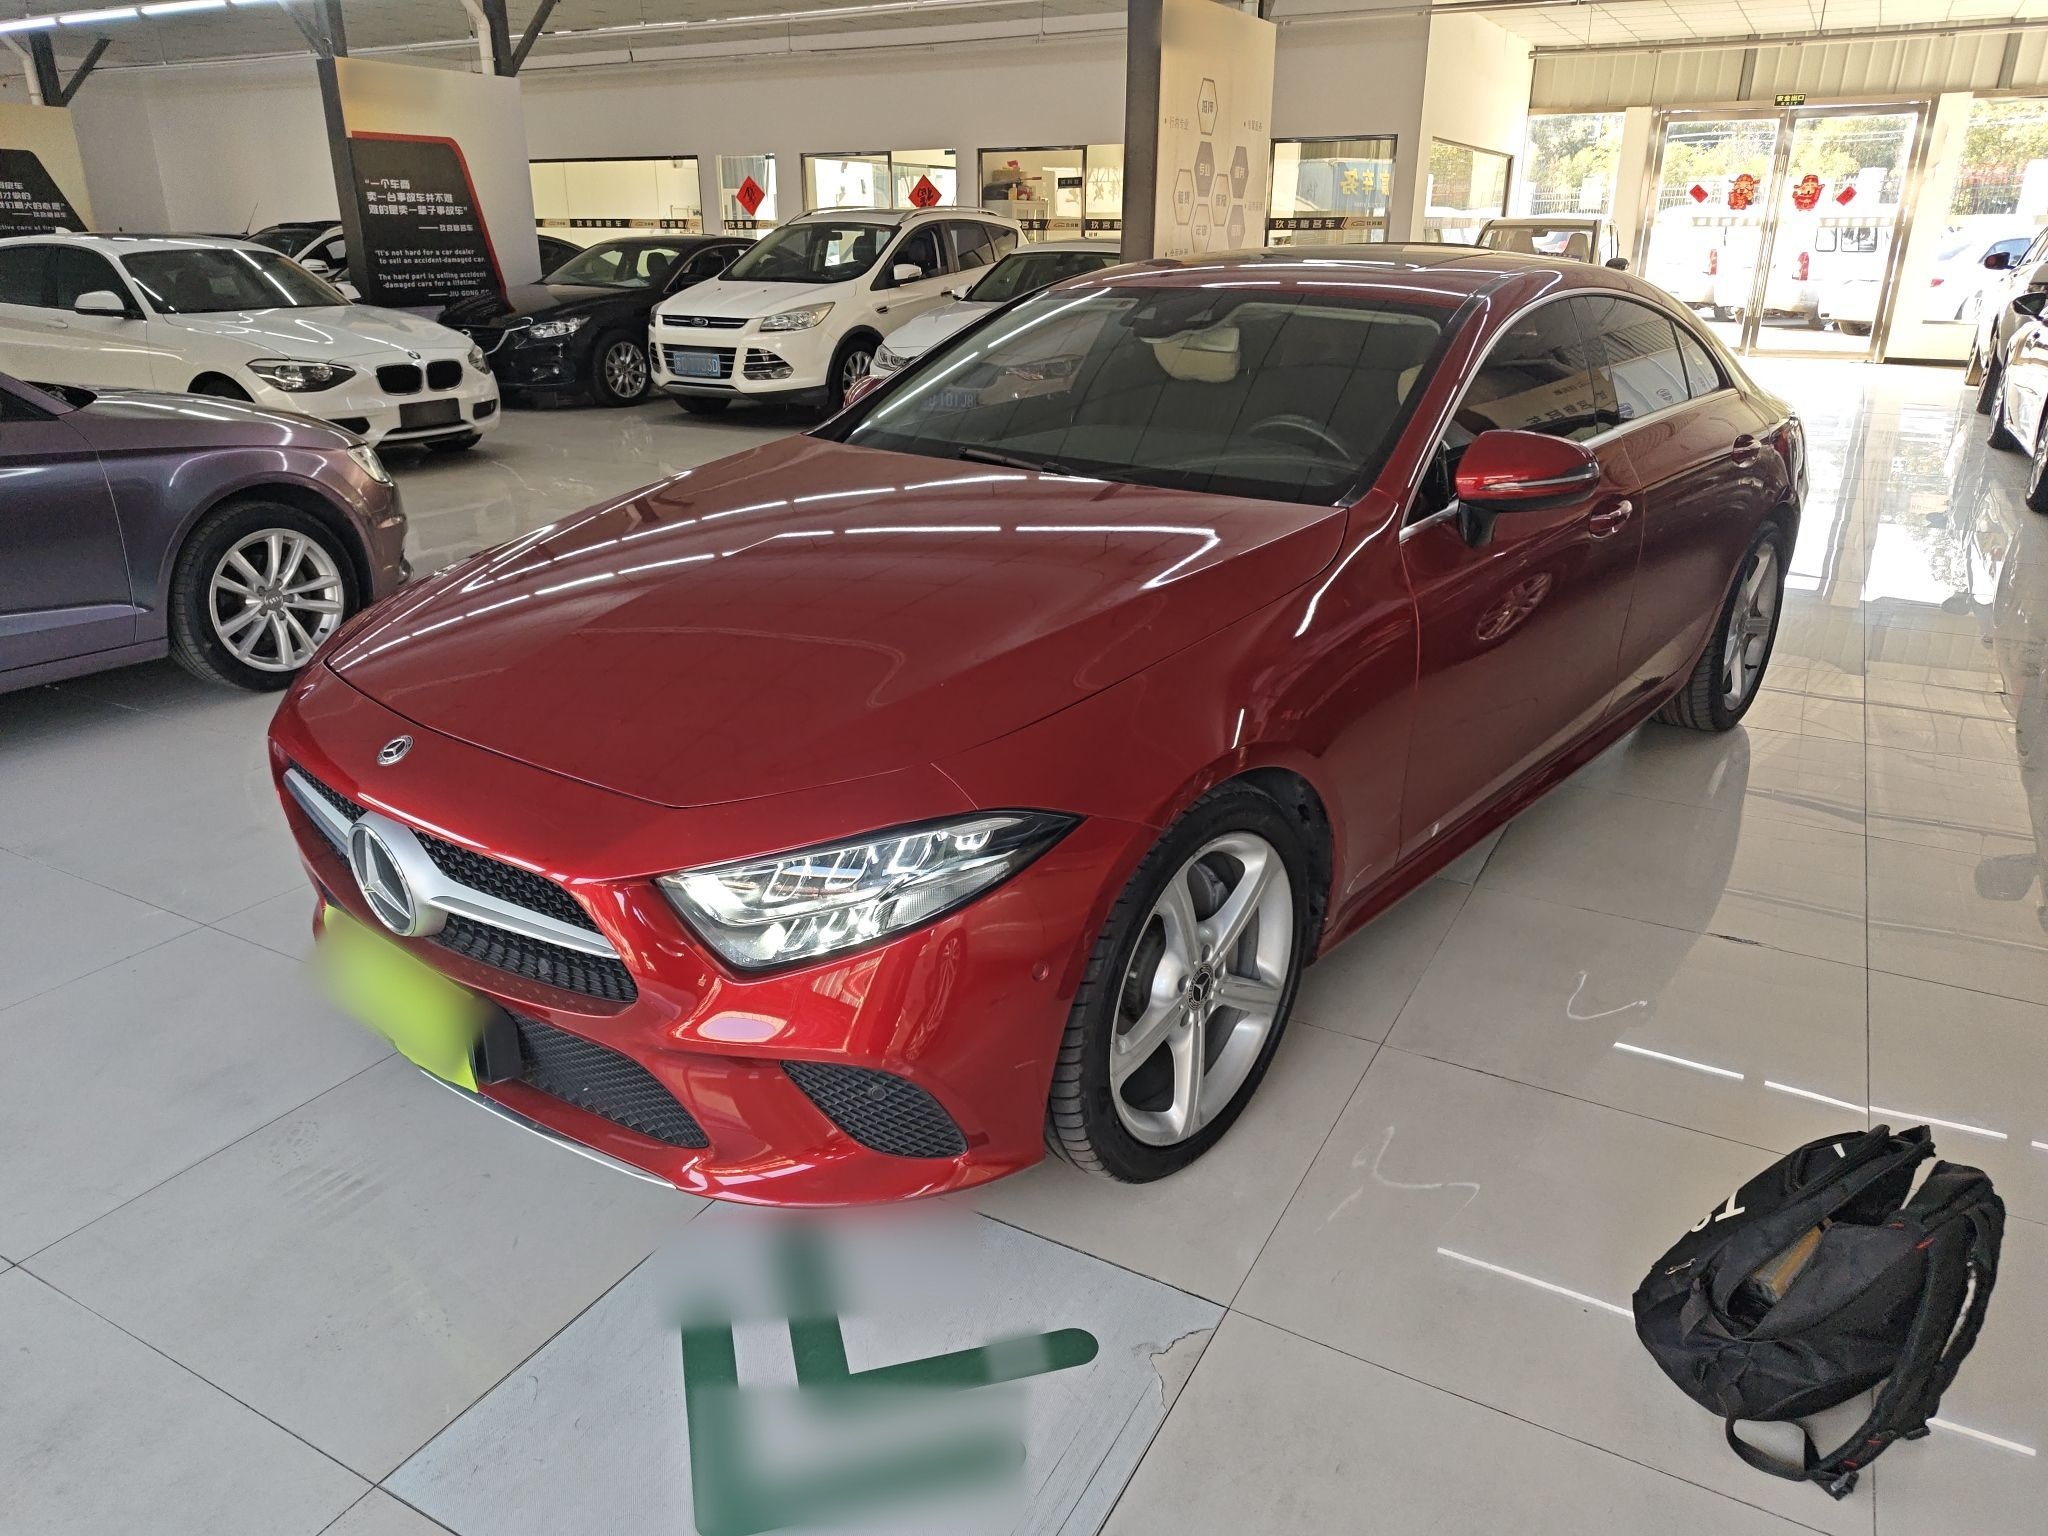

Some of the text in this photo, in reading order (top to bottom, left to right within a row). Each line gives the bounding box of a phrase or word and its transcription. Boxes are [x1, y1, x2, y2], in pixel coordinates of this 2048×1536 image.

[366, 191, 454, 203] 卖一台事故车并不难
[1275, 220, 1335, 229] 玖宫格名车
[411, 273, 426, 281] part
[436, 271, 458, 280] selling
